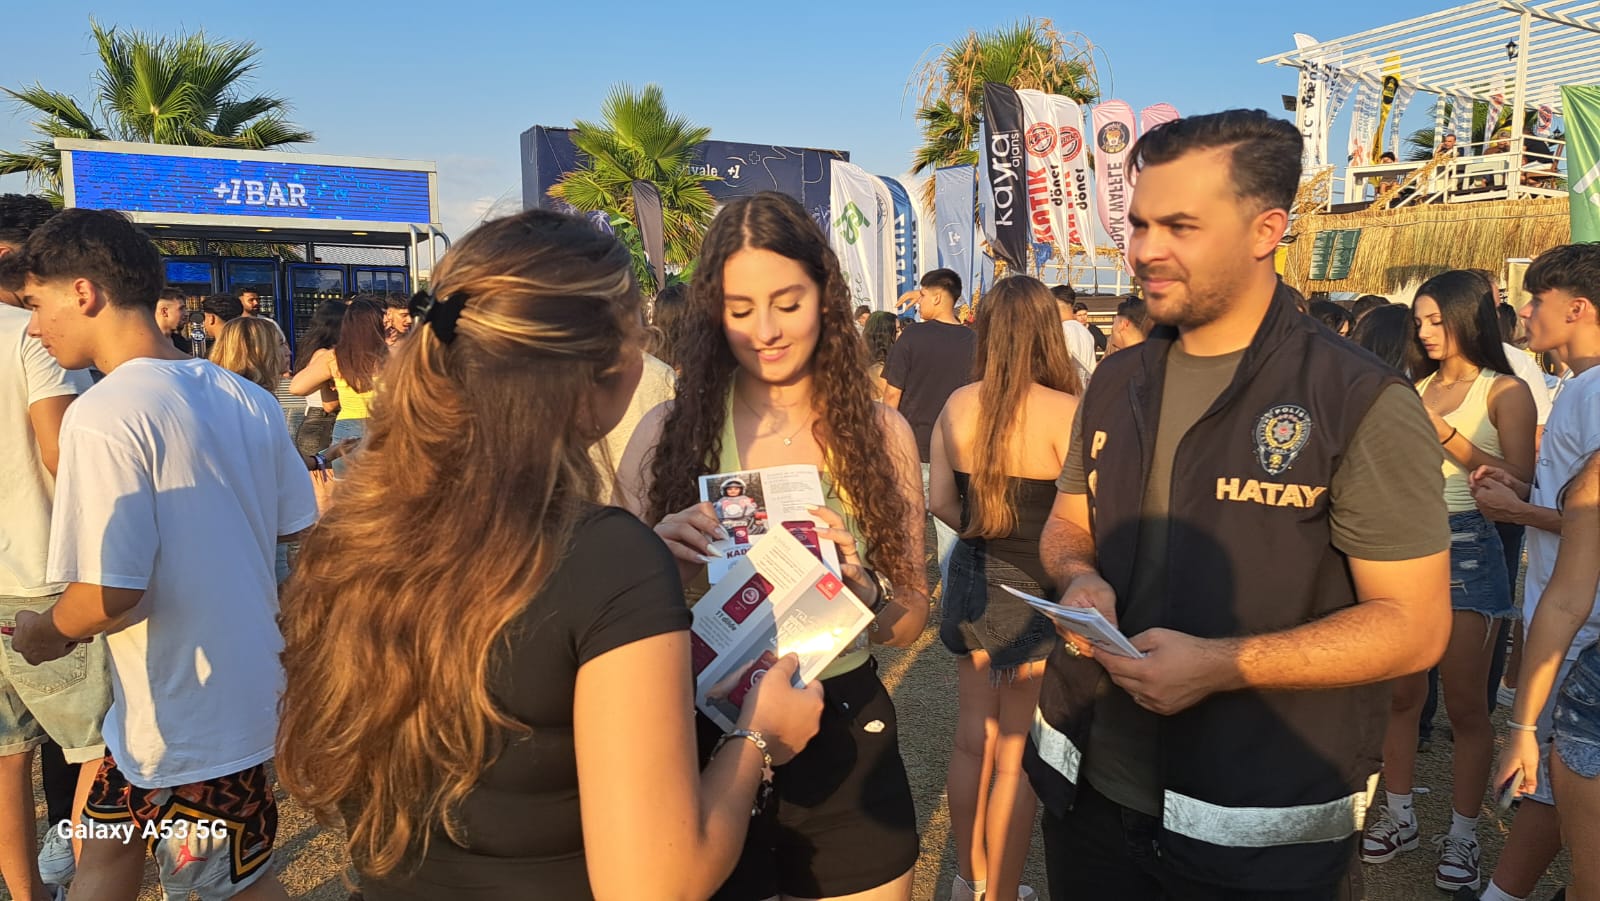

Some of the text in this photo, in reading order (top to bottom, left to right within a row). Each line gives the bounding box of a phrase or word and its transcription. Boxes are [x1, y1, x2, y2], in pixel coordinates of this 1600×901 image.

[1010, 131, 1023, 168] ajans
[991, 133, 1019, 226] kayra
[1050, 164, 1063, 207] döner
[1074, 168, 1088, 211] döner
[1216, 477, 1328, 508] HATAY
